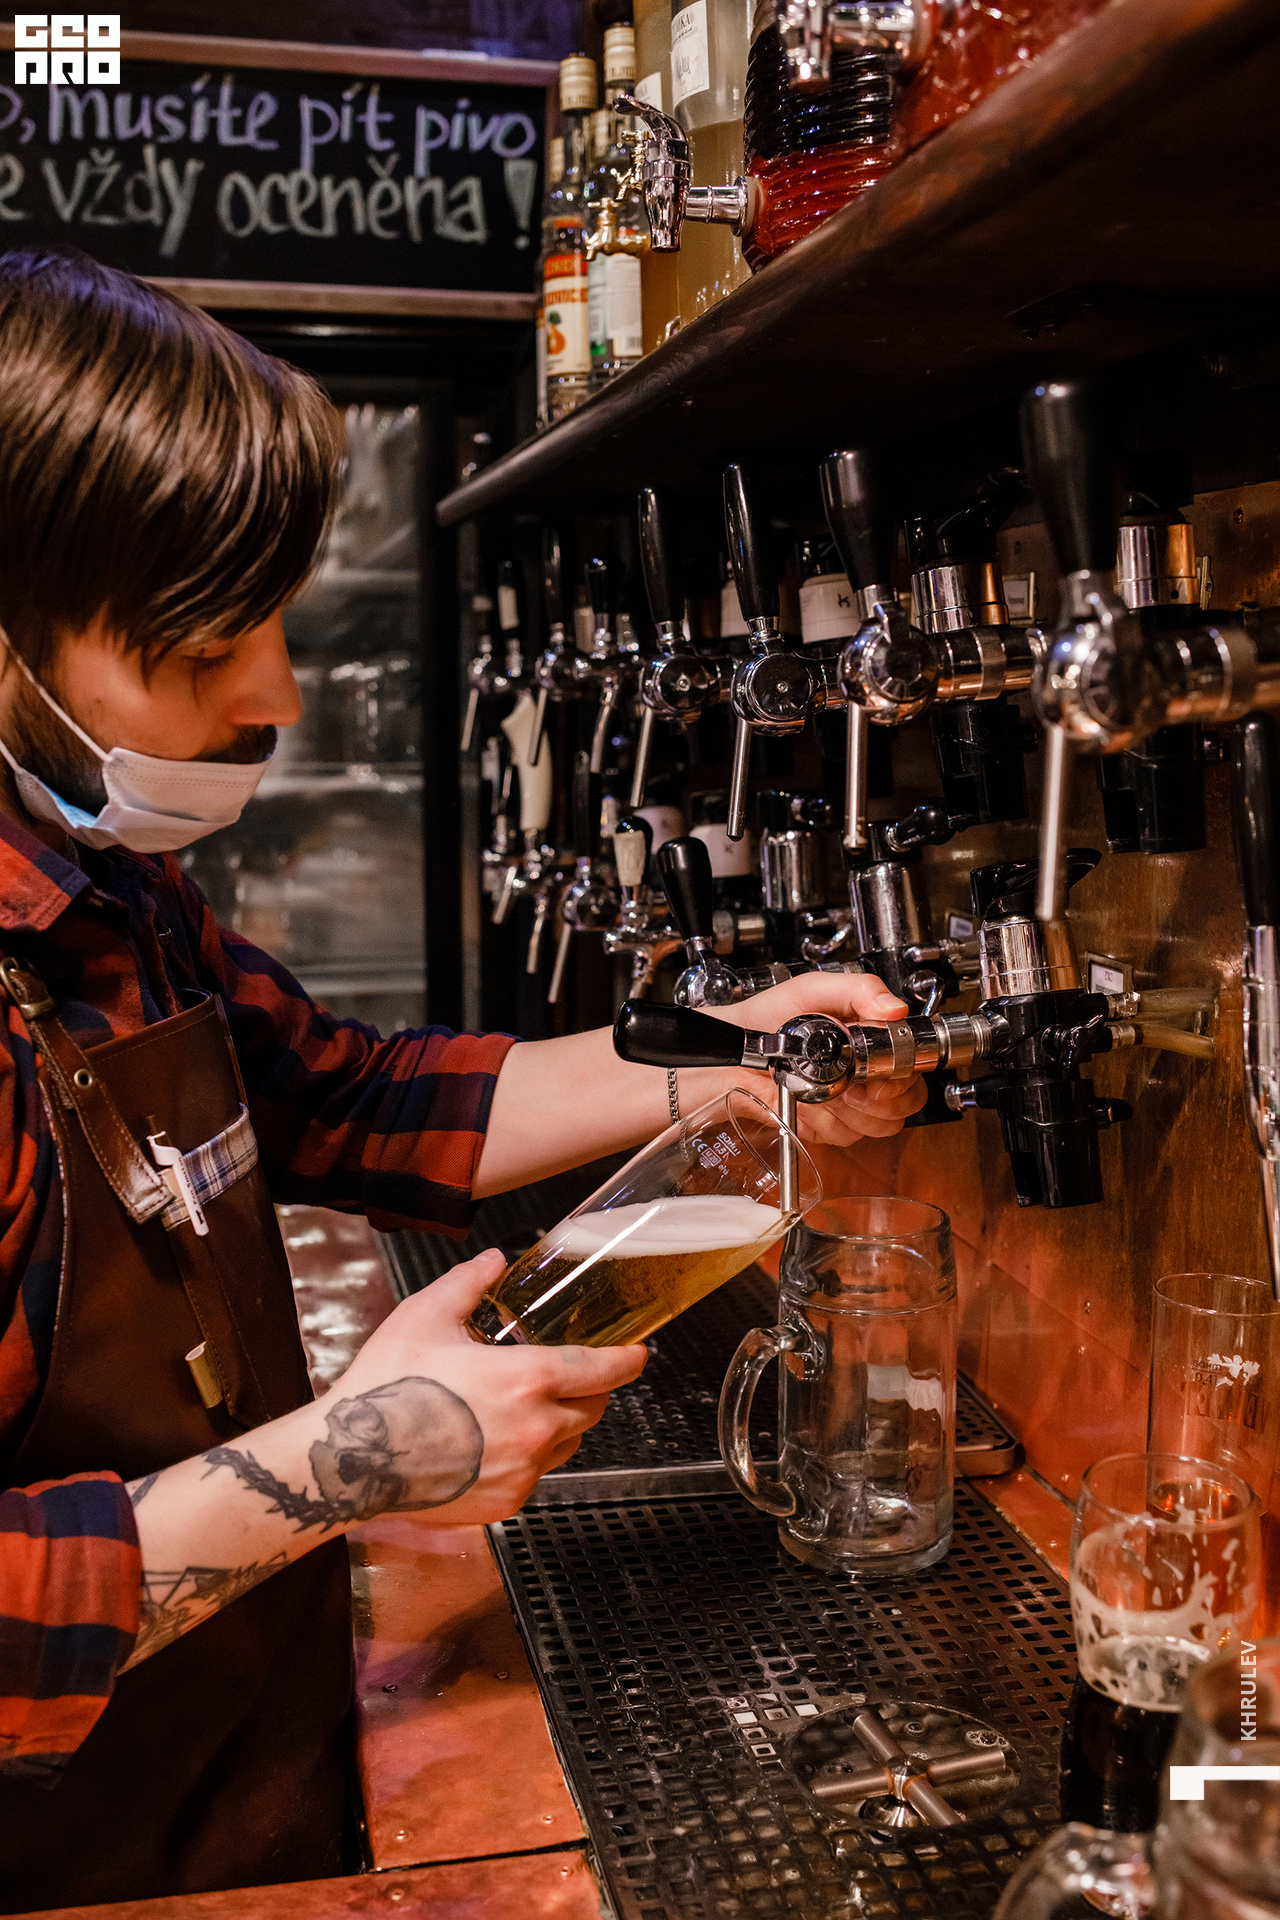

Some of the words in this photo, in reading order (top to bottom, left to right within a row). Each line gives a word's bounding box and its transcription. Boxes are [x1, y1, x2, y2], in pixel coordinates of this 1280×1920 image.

[48, 72, 279, 148] musíte
[299, 82, 395, 173] pít
[414, 98, 536, 177] pivo
[41, 143, 204, 258] vždy
